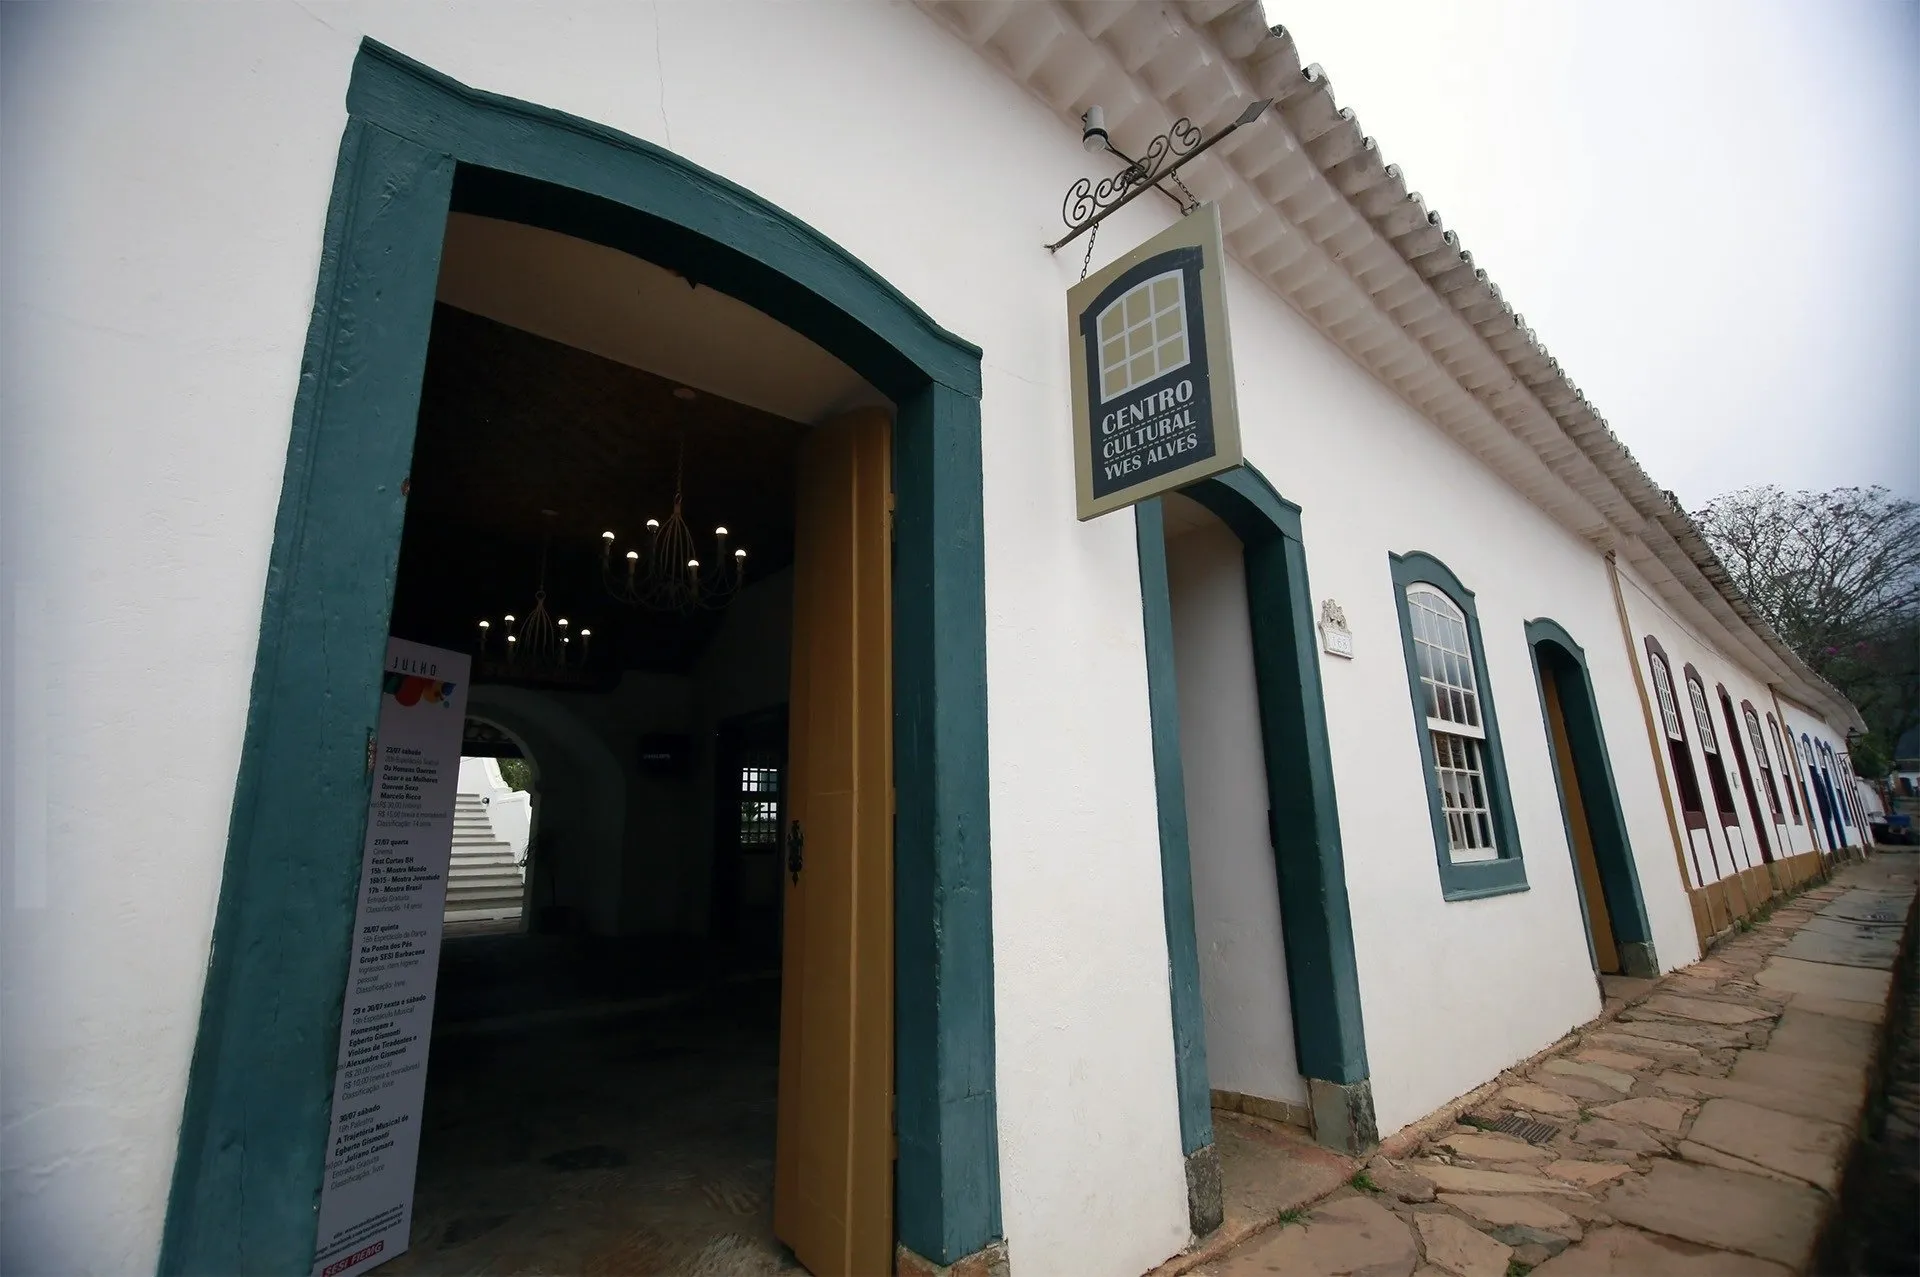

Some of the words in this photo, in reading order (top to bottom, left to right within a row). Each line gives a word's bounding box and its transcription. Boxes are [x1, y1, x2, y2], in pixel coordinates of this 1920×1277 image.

[1102, 380, 1193, 435] CENTRO
[1103, 410, 1196, 459] CULTURAL
[1104, 455, 1142, 480] YVES
[1147, 433, 1198, 465] ALVES
[393, 656, 437, 676] JULHO
[383, 1001, 400, 1009] sexta
[350, 1023, 389, 1036] Homenagem
[349, 1036, 373, 1047] Egberto
[346, 1055, 379, 1068] Alexandre
[336, 1137, 342, 1145] A
[375, 1115, 401, 1131] Musical
[335, 1143, 361, 1156] Egberto
[345, 1149, 369, 1163] Juliano
[351, 1242, 384, 1266] FIEMG
